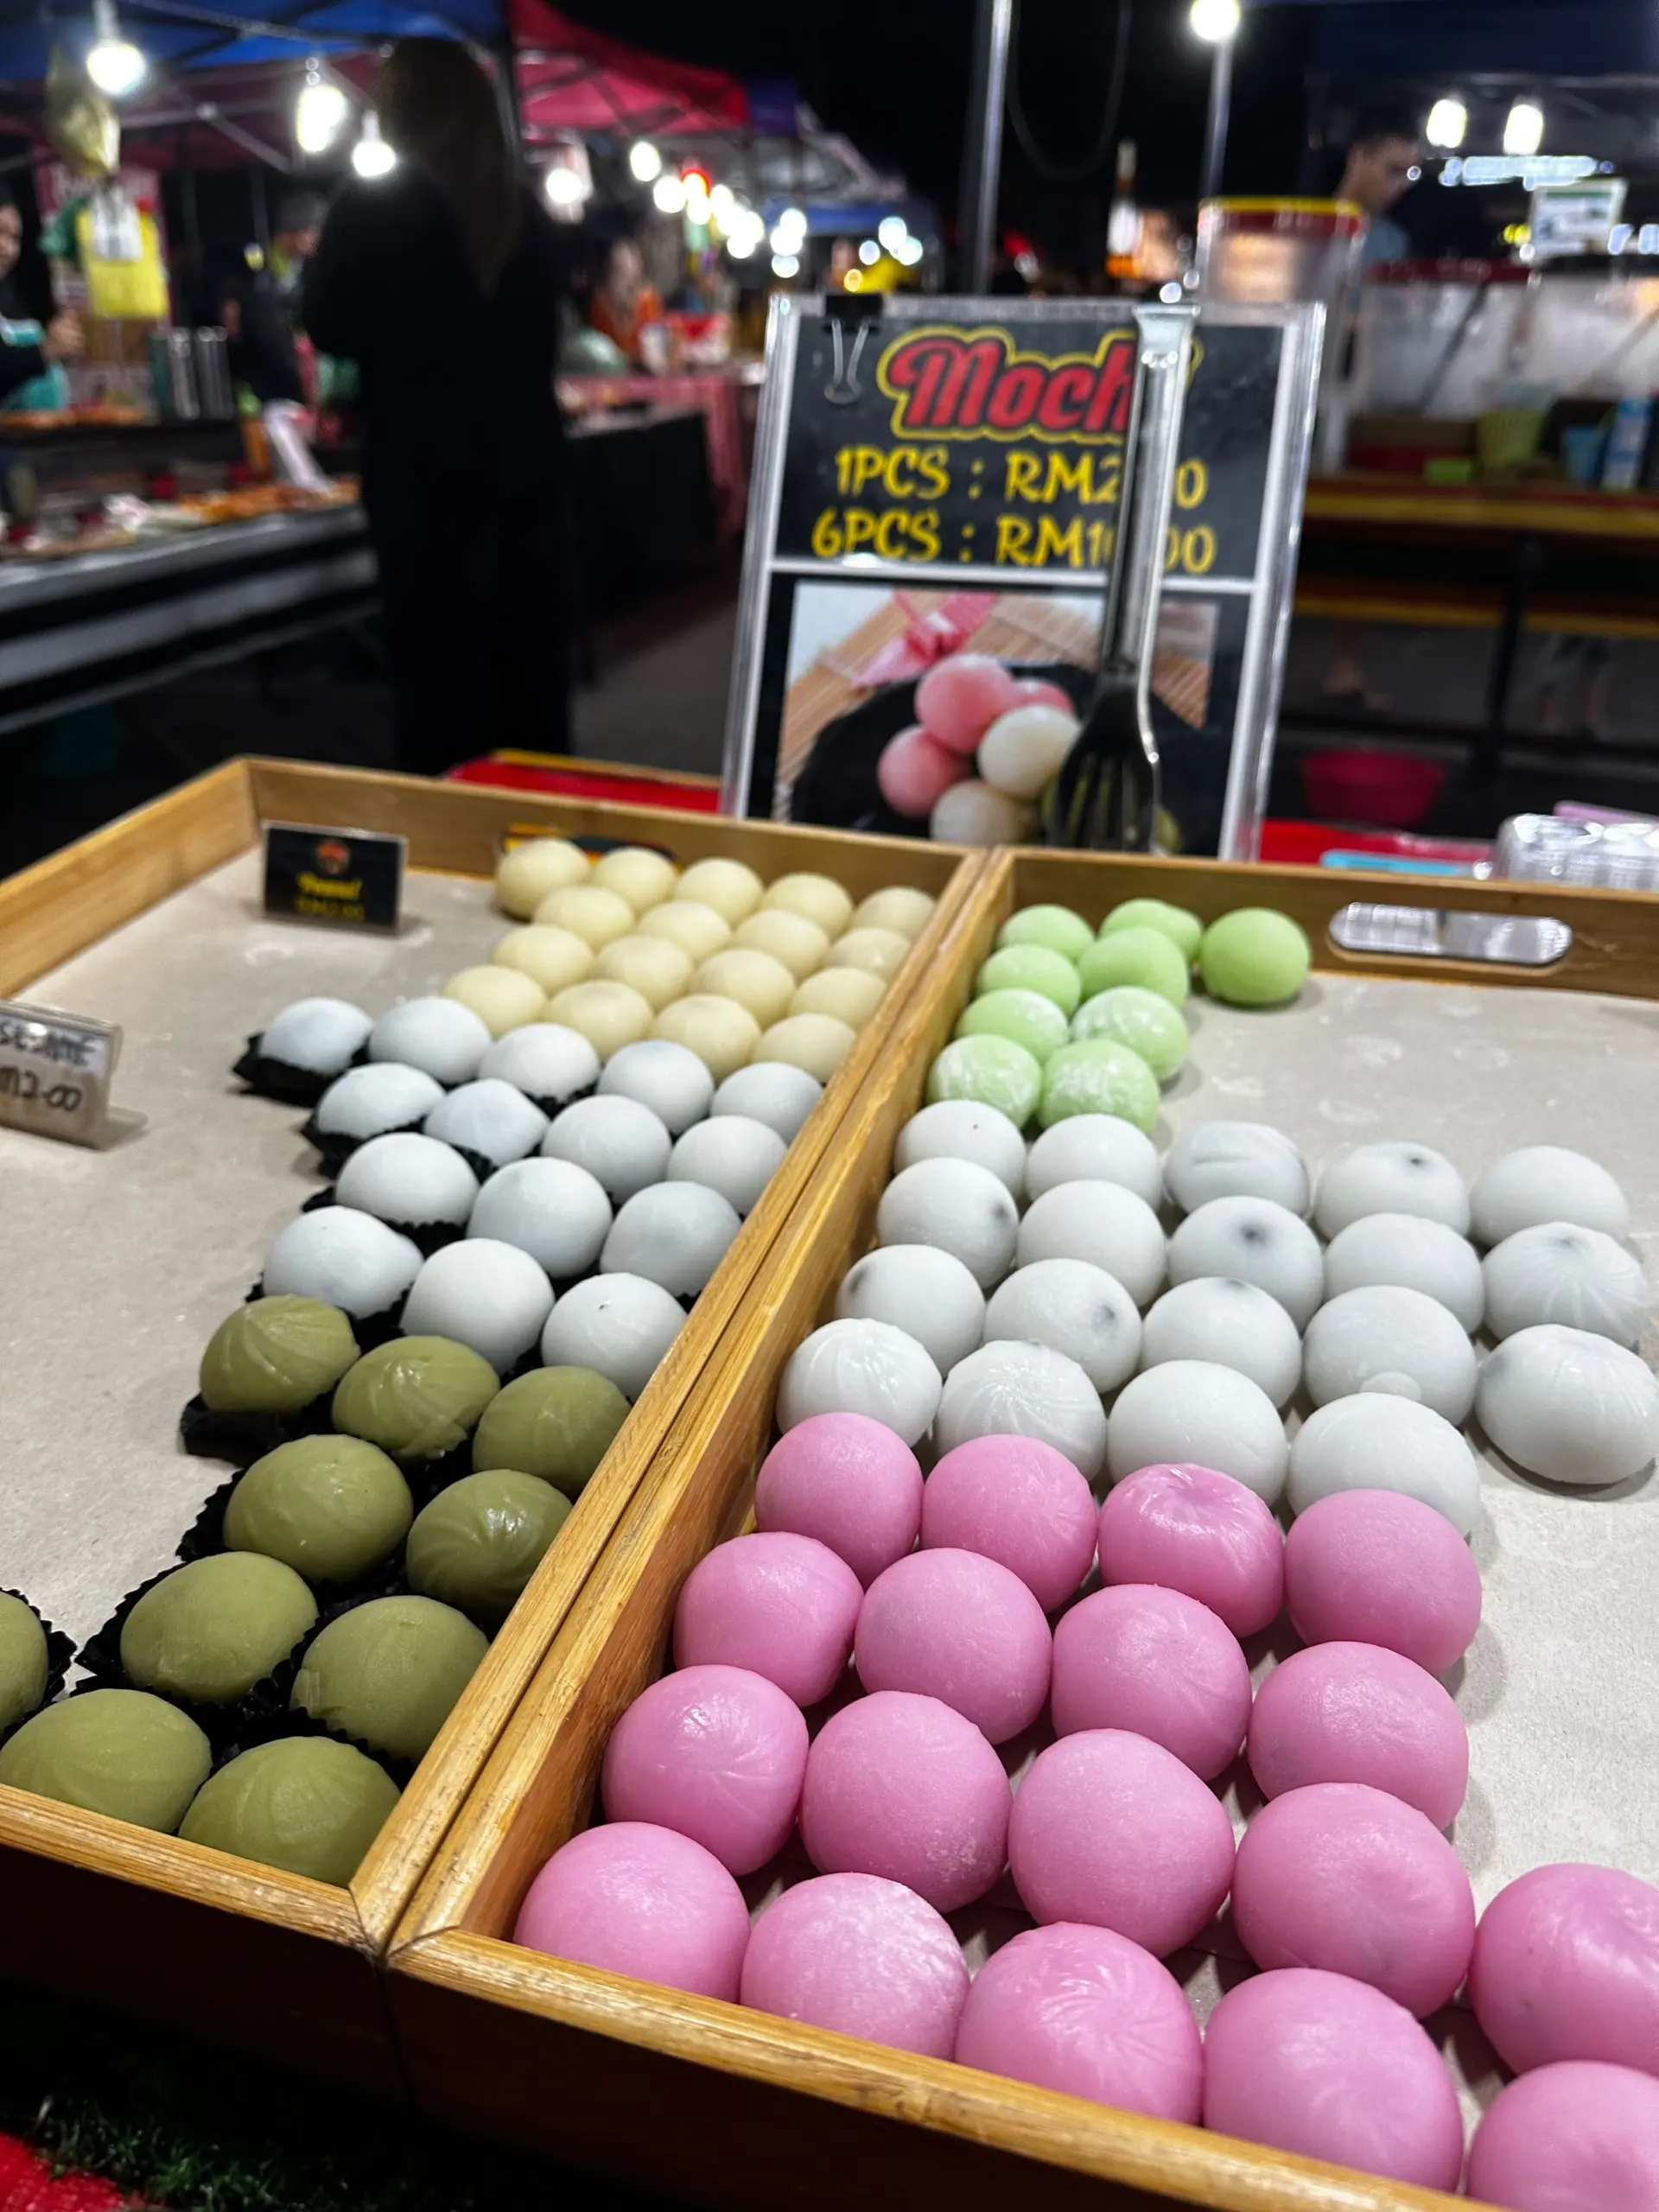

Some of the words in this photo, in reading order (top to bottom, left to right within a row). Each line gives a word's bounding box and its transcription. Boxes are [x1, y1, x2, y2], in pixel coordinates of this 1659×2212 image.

[880, 330, 1203, 439] Moch
[835, 443, 951, 499] 1PCS
[968, 458, 985, 500] :
[1003, 448, 1207, 510] RM20
[810, 505, 942, 563] 6PCS
[958, 522, 976, 563] :
